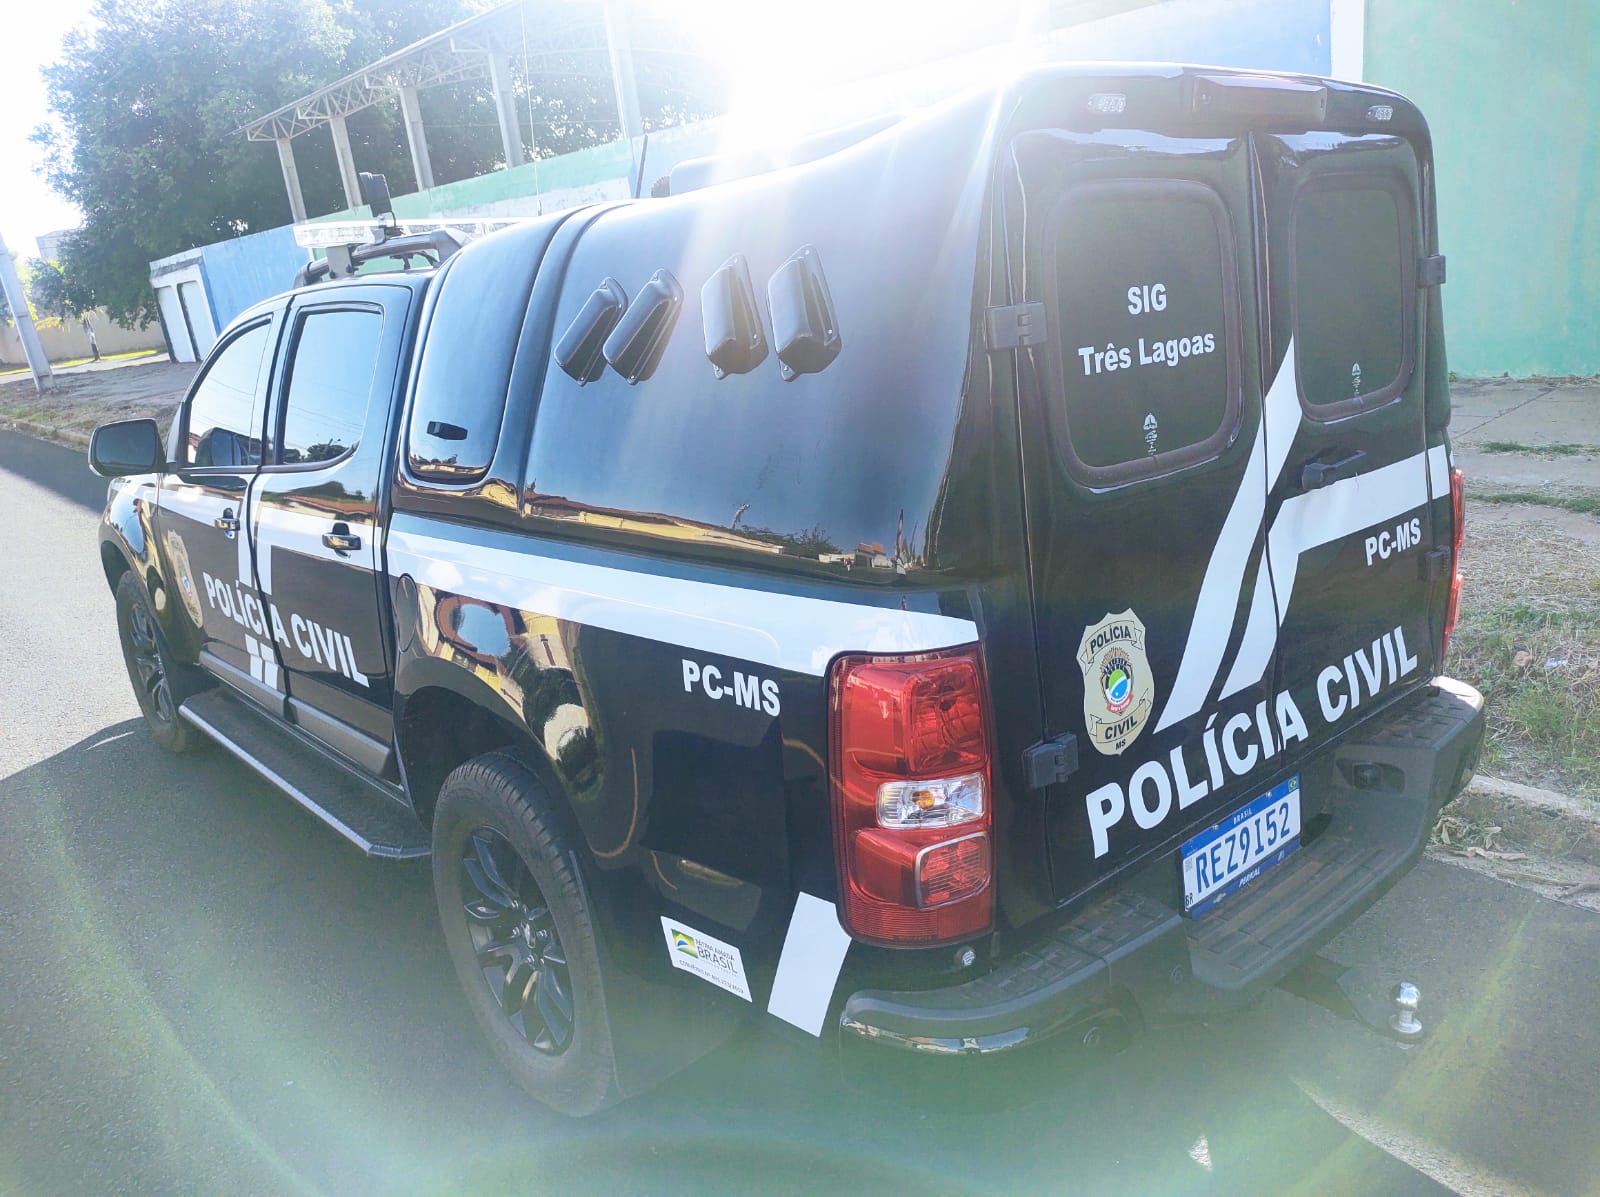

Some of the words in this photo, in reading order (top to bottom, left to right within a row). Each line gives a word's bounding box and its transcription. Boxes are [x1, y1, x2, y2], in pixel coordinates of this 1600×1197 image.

[1127, 283, 1167, 315] SIG
[1078, 343, 1132, 376] Três
[1139, 332, 1215, 368] Lagoas
[1365, 518, 1421, 566] PC-MS
[203, 571, 291, 648] POLÍCIA
[290, 613, 370, 688] CIVIL
[1090, 625, 1132, 654] POLÍCIA
[682, 659, 780, 717] PC-MS
[1085, 689, 1309, 860] POLÍCIA
[1316, 625, 1418, 723] CIVIL
[1105, 716, 1138, 740] CIVIL
[1115, 739, 1126, 750] MS
[1233, 807, 1253, 824] BRASIL
[697, 946, 738, 974] BRASIL
